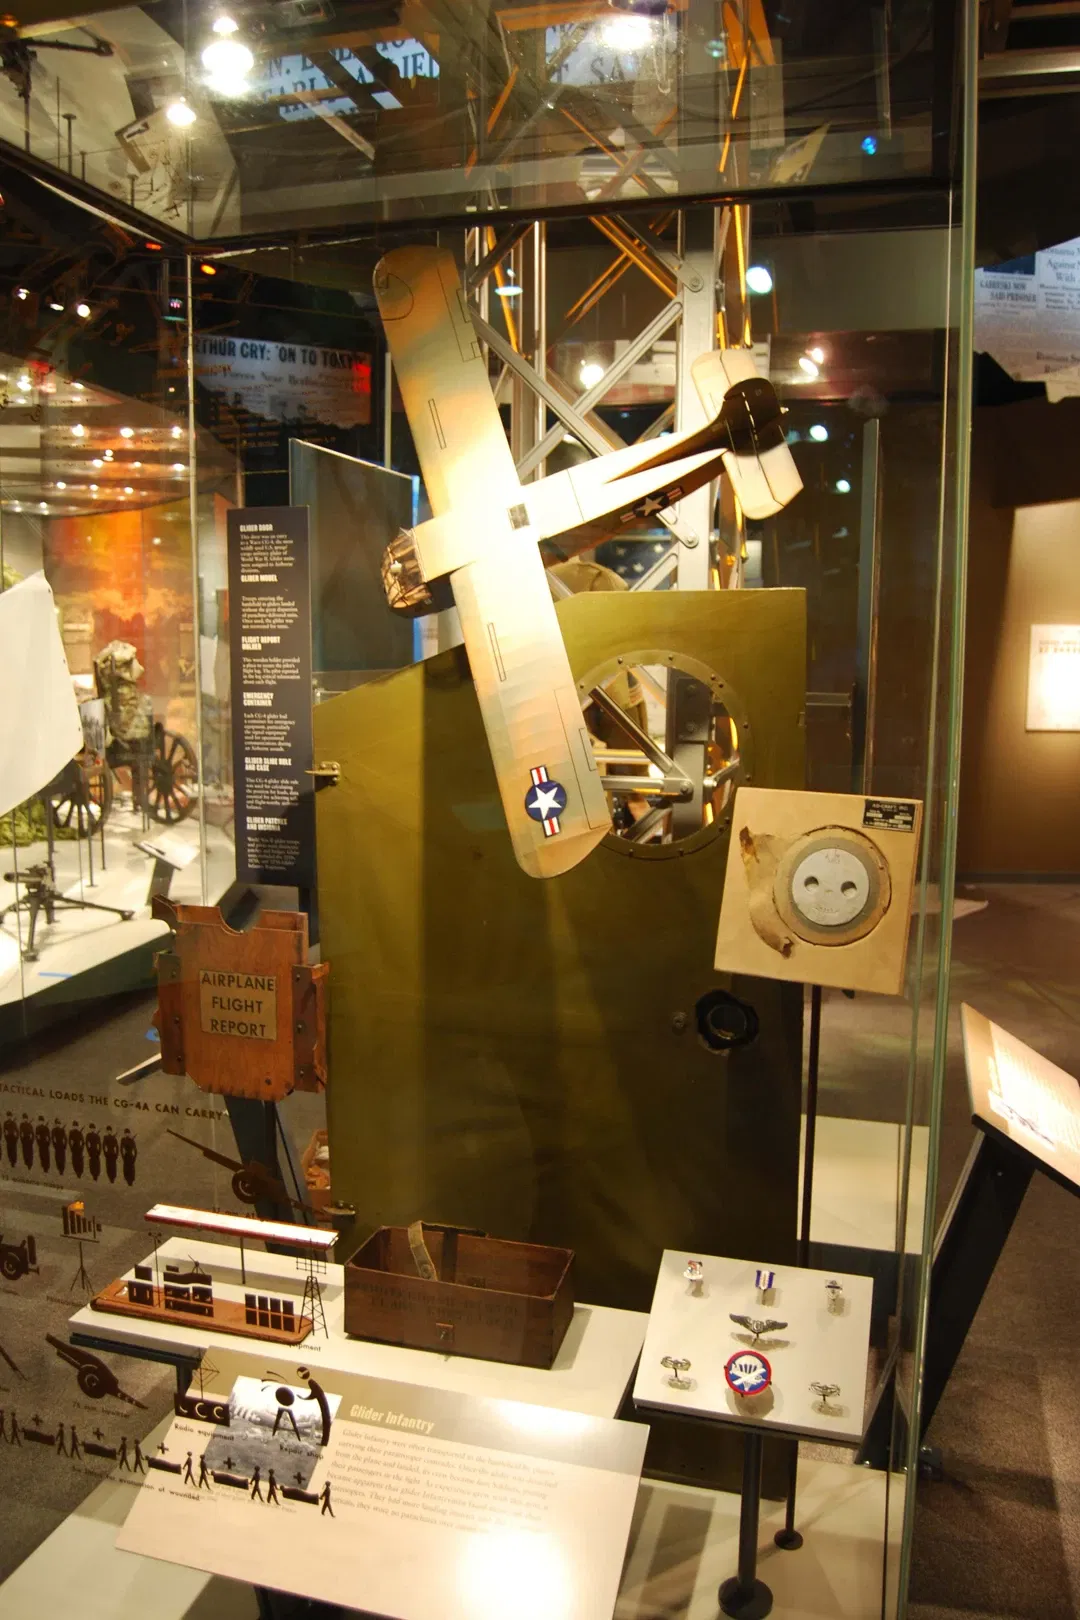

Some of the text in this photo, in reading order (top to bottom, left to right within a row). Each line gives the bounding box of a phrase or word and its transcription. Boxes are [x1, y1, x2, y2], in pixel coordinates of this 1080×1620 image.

[201, 972, 275, 992] AIRPLANE
[211, 996, 263, 1014] FLIGHT
[210, 1019, 266, 1037] REPORT
[50, 1089, 84, 1103] LOADS
[89, 1095, 109, 1106] THE
[114, 1099, 150, 1113] CG-4A
[155, 1103, 179, 1116] CAN
[185, 1107, 223, 1121] CARRY
[174, 1422, 194, 1433] Radio
[350, 1404, 435, 1434] Glider Infantry
[168, 1489, 200, 1501] wounded
